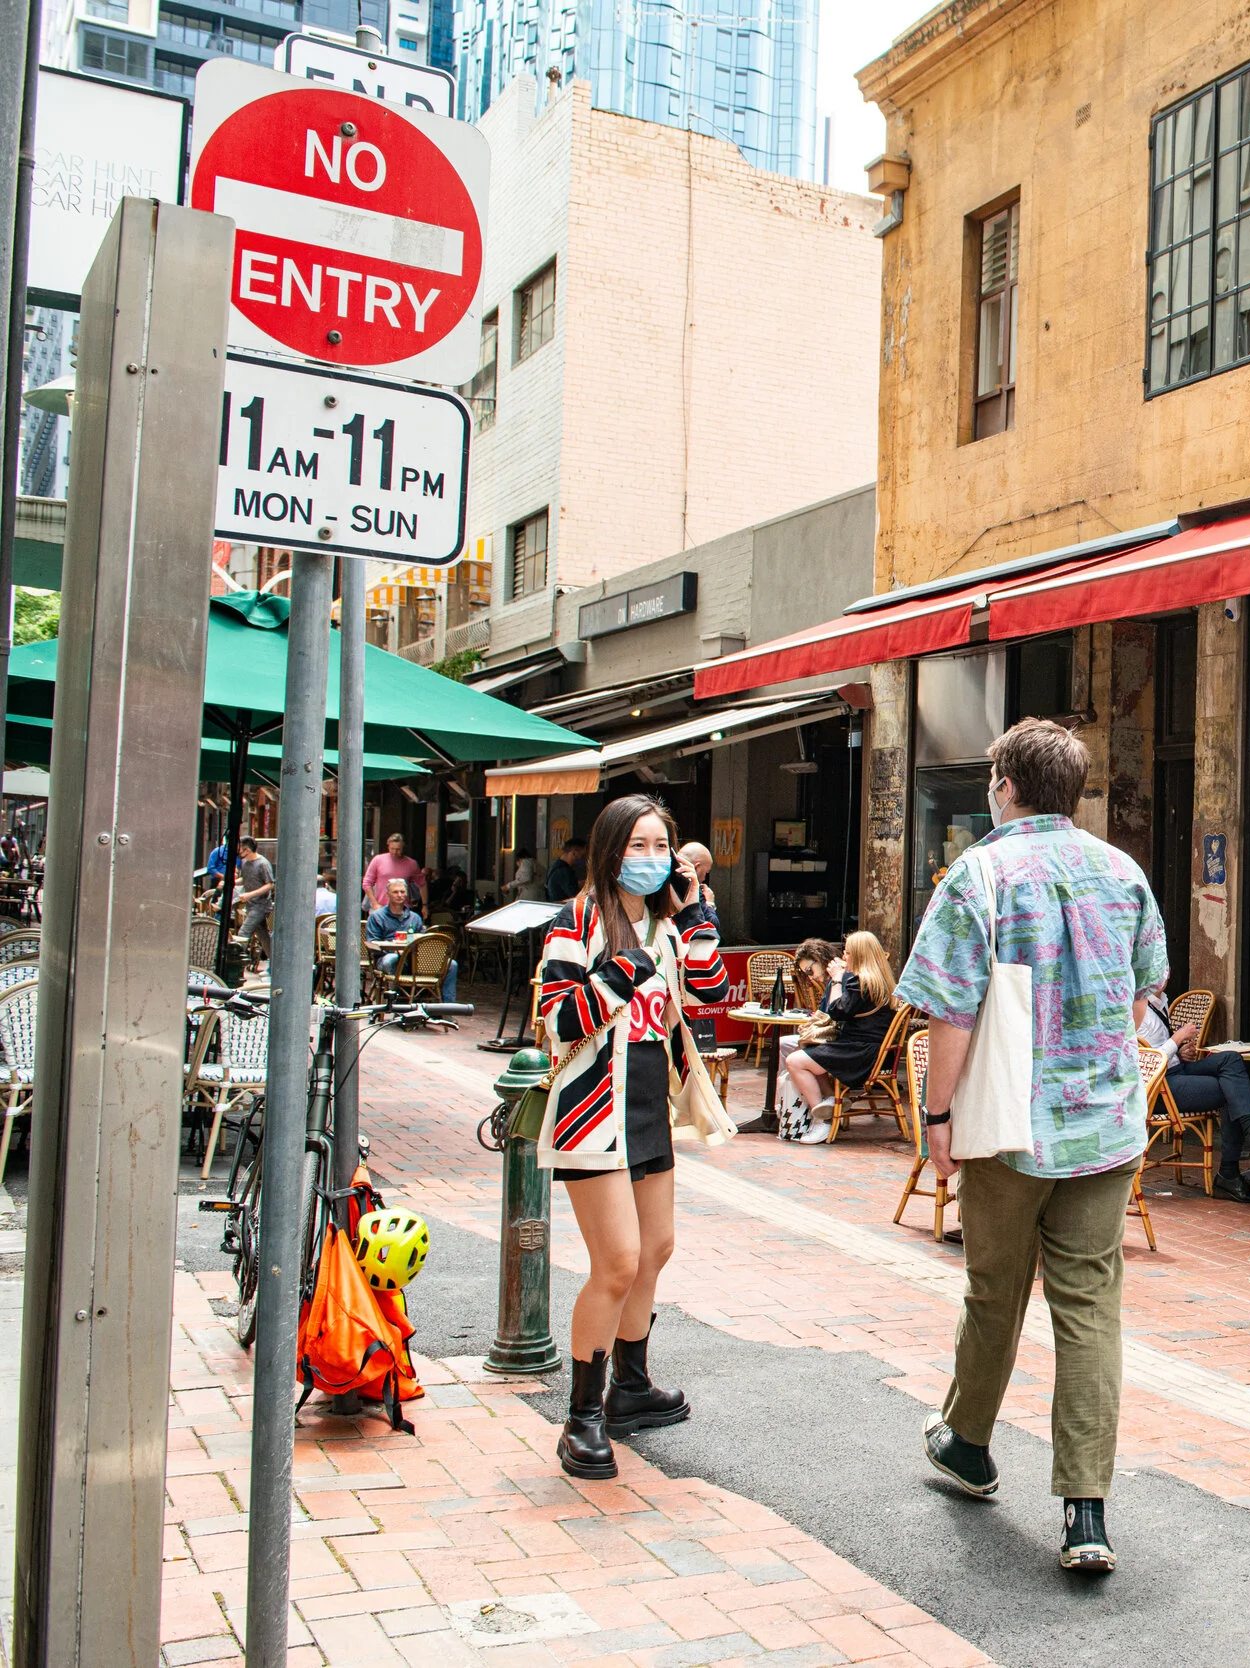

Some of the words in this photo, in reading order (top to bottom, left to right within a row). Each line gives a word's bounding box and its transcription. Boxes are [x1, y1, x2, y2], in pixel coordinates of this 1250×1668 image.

[34, 147, 84, 175] CAR
[94, 160, 162, 188] HUNT
[304, 128, 387, 192] NO
[31, 167, 83, 194] CAR
[31, 186, 81, 214] CAR
[239, 248, 442, 333] ENTRY
[233, 487, 313, 525] MON
[350, 504, 418, 540] SUN
[631, 595, 664, 620] HARDWARE
[714, 829, 737, 856] MAX
[697, 1006, 725, 1015] SLOWLY
